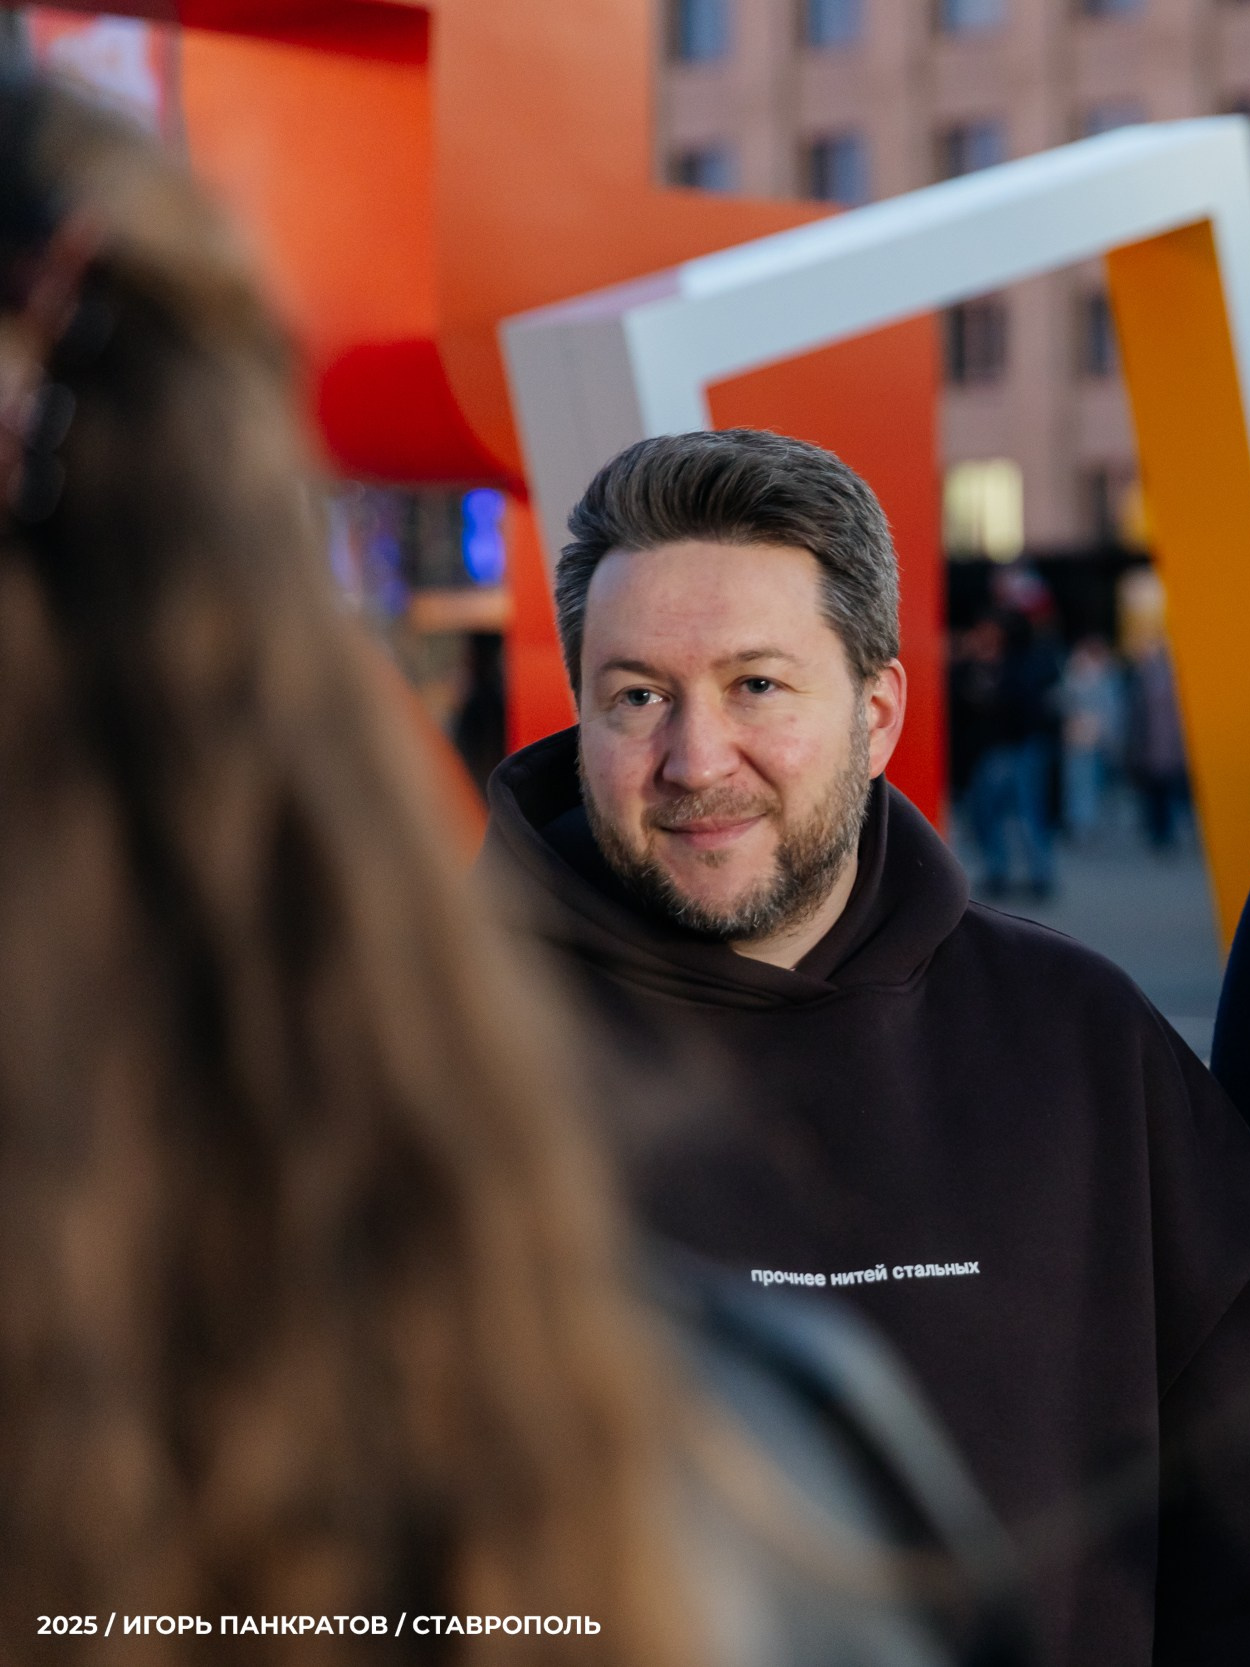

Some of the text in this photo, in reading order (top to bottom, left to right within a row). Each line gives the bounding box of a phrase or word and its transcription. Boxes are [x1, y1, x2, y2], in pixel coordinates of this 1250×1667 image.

[750, 1260, 981, 1287] прочнее нитей стальных
